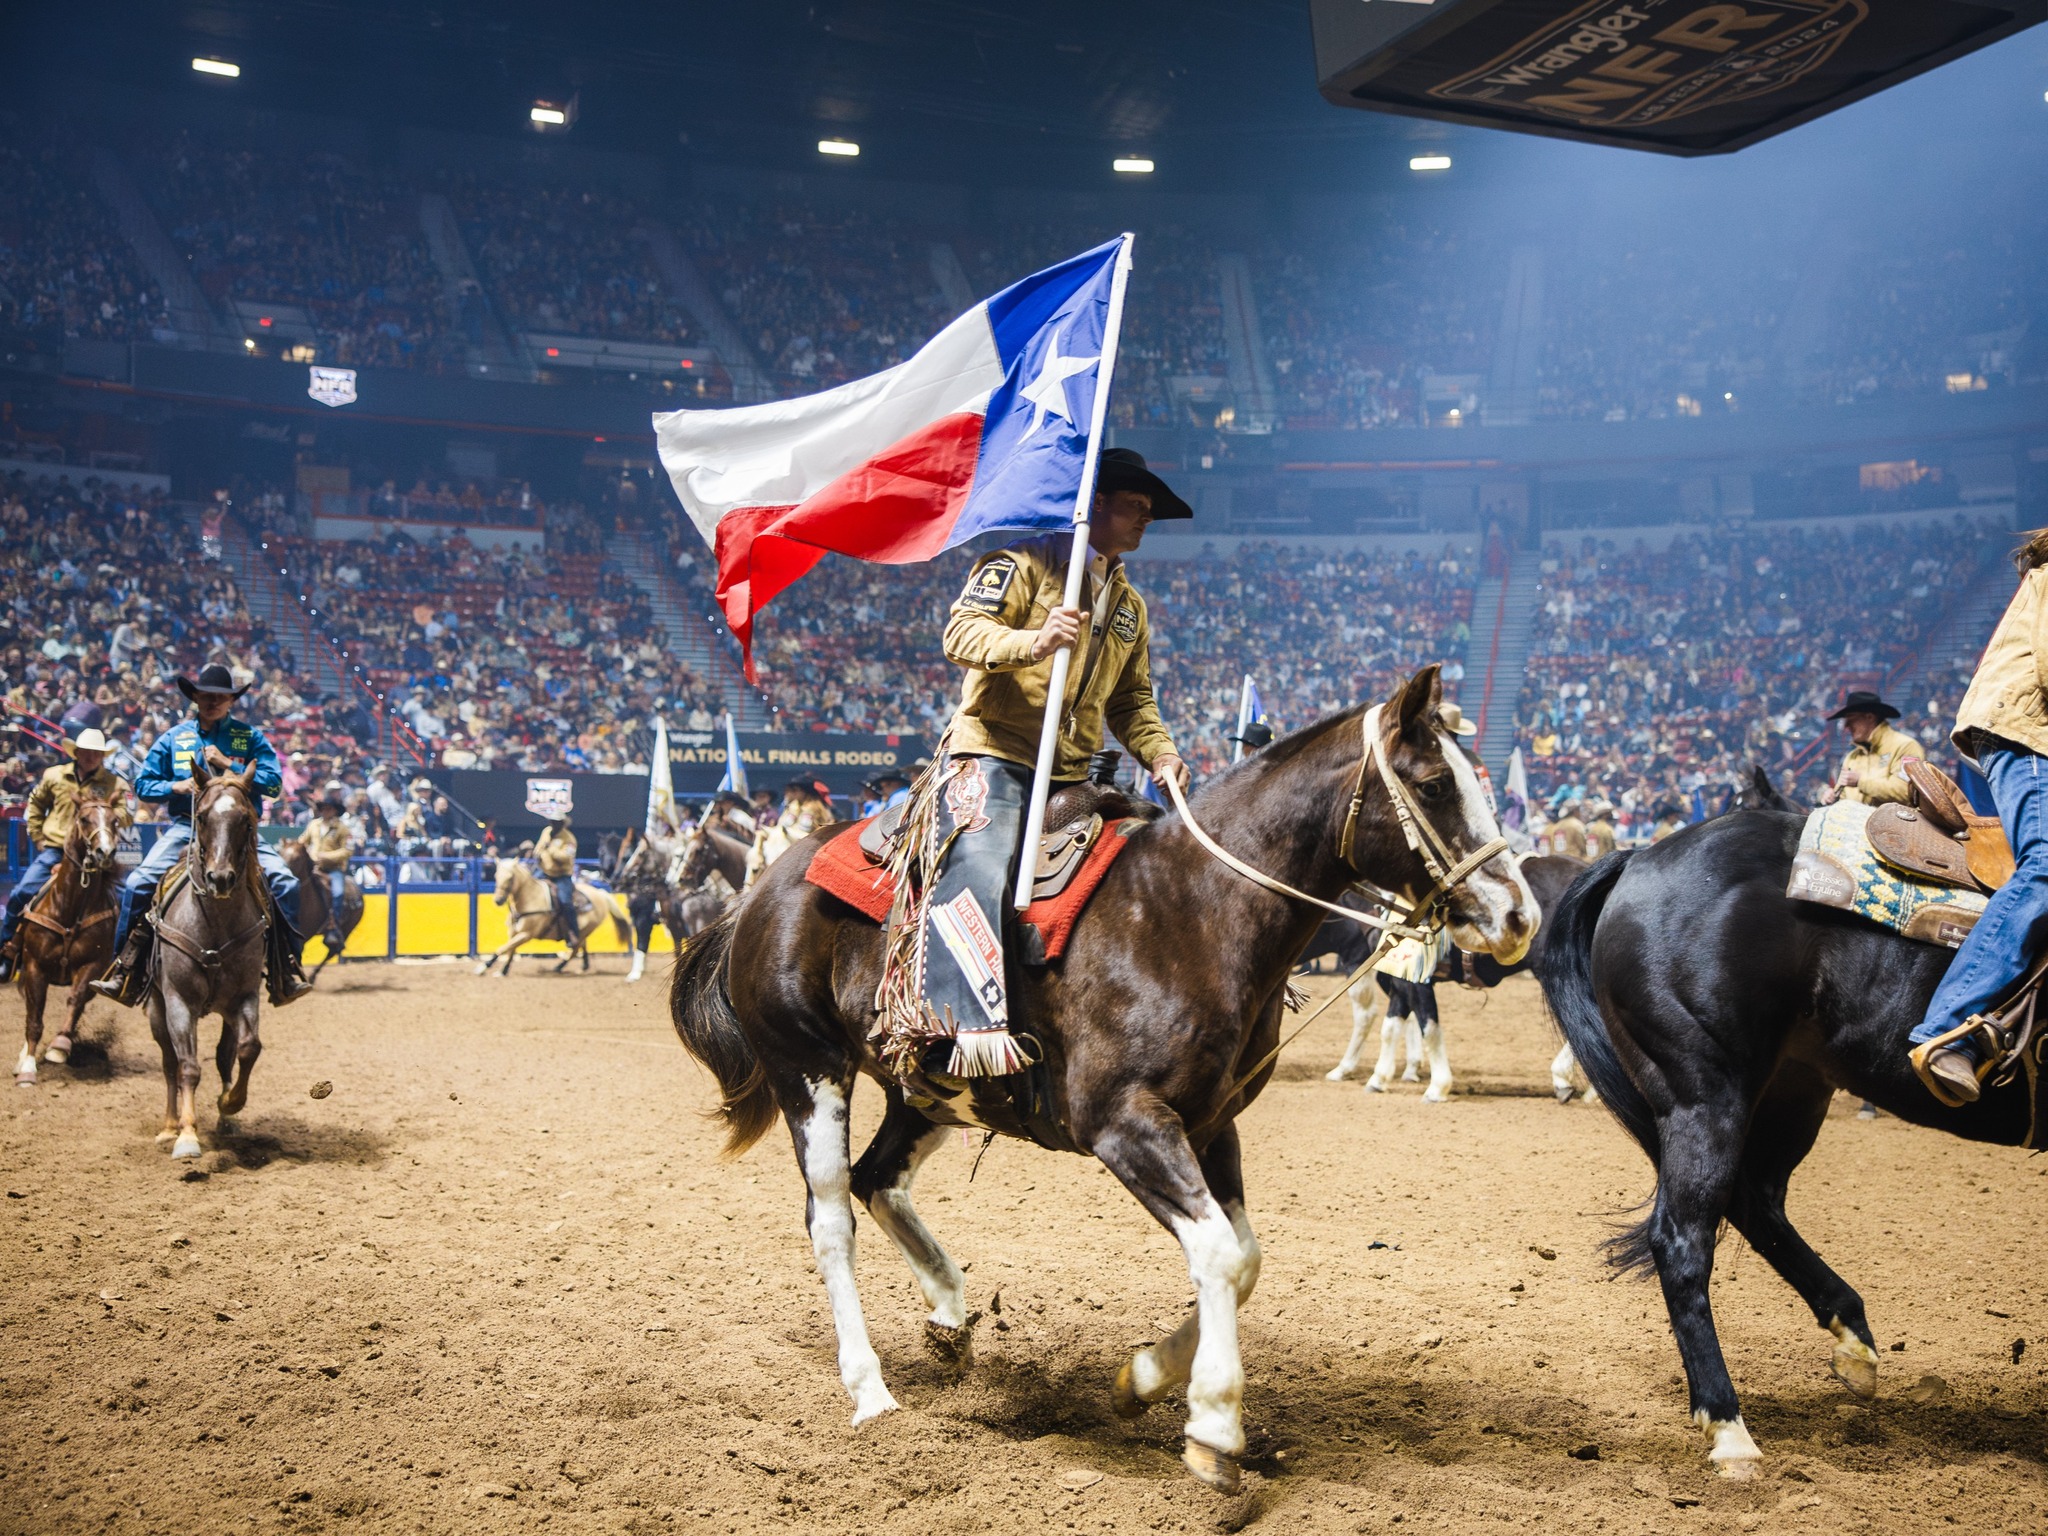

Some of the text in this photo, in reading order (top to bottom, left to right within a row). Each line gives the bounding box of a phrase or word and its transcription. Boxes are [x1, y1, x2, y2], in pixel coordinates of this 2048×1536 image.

[1483, 4, 1650, 86] Wrangler
[1764, 19, 1839, 56] 2024
[1525, 4, 1785, 114] NFR
[1116, 614, 1135, 631] NFR
[669, 748, 897, 766] NATIOAL FINALS RODEO
[1810, 881, 1841, 897] Equine
[1811, 871, 1843, 887] Classic
[955, 897, 993, 957] WESTERN
